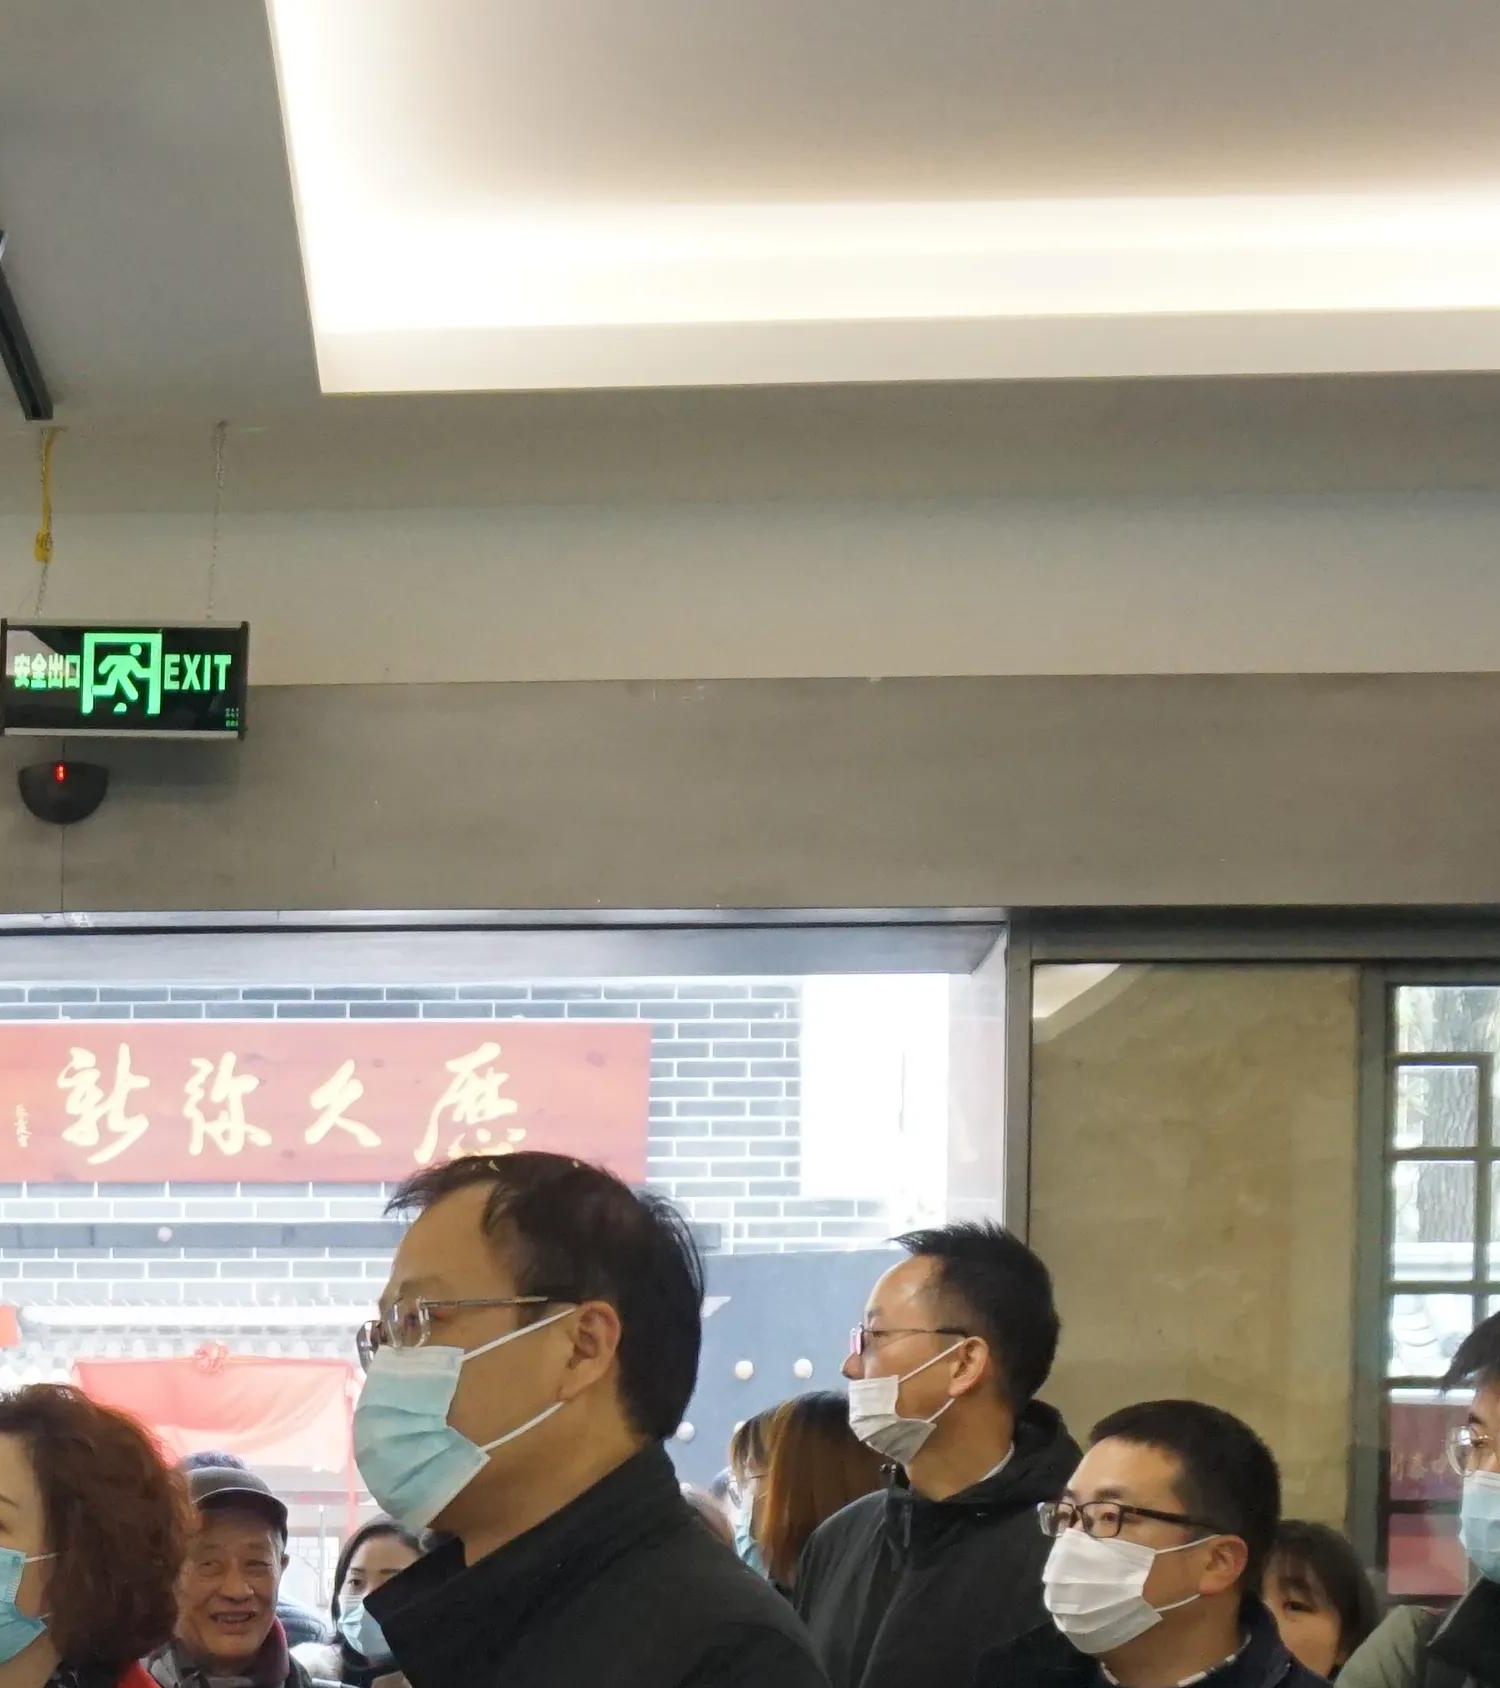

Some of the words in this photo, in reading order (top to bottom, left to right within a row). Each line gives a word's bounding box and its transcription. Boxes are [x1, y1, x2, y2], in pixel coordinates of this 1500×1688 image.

[13, 653, 81, 689] 安全出口
[164, 653, 232, 690] EXIT
